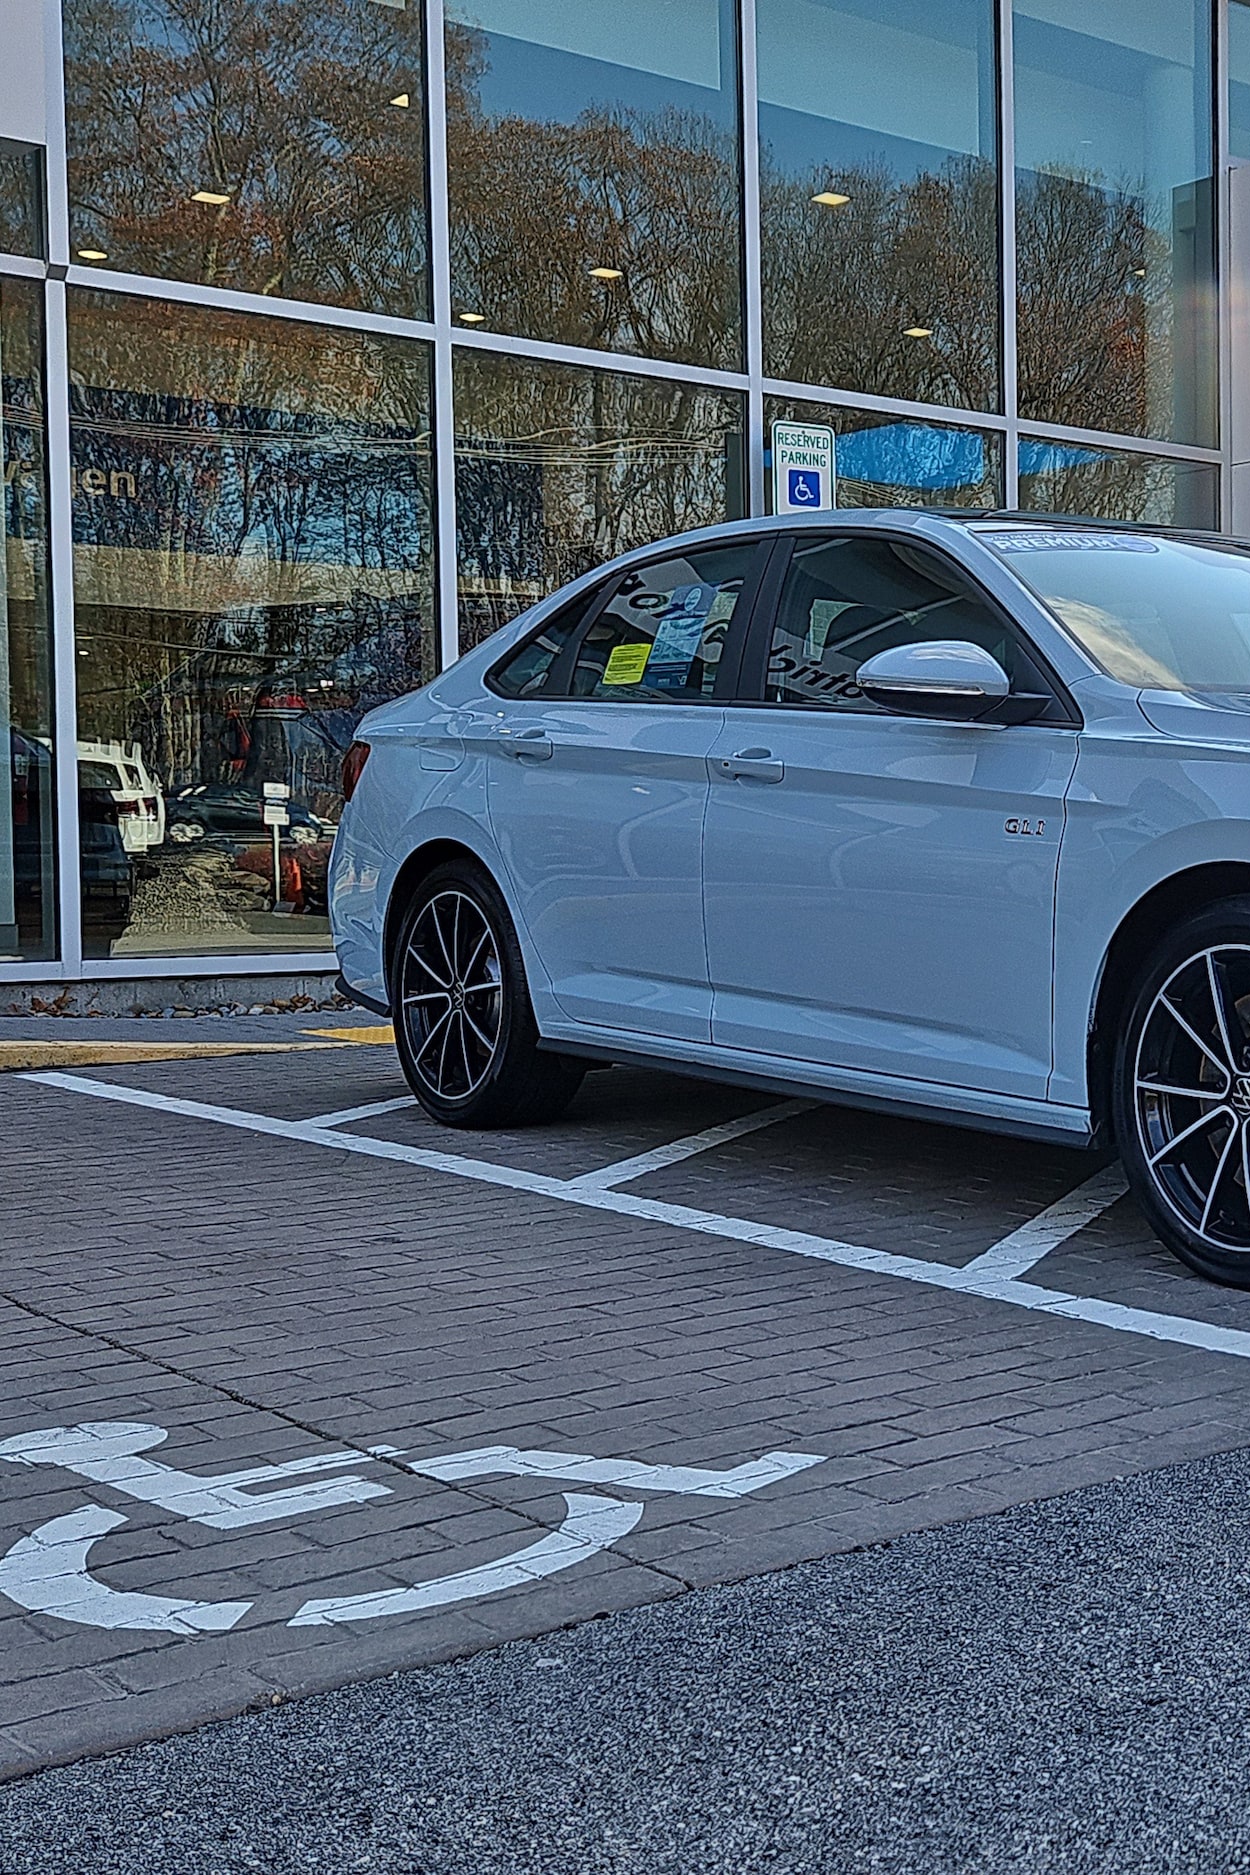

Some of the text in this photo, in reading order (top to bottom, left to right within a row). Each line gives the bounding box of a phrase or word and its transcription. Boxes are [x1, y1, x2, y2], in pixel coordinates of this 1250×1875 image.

[777, 431, 829, 450] RESERVED
[781, 450, 826, 468] PARKING
[993, 536, 1115, 551] PREMIUM
[1005, 818, 1046, 836] GLI
